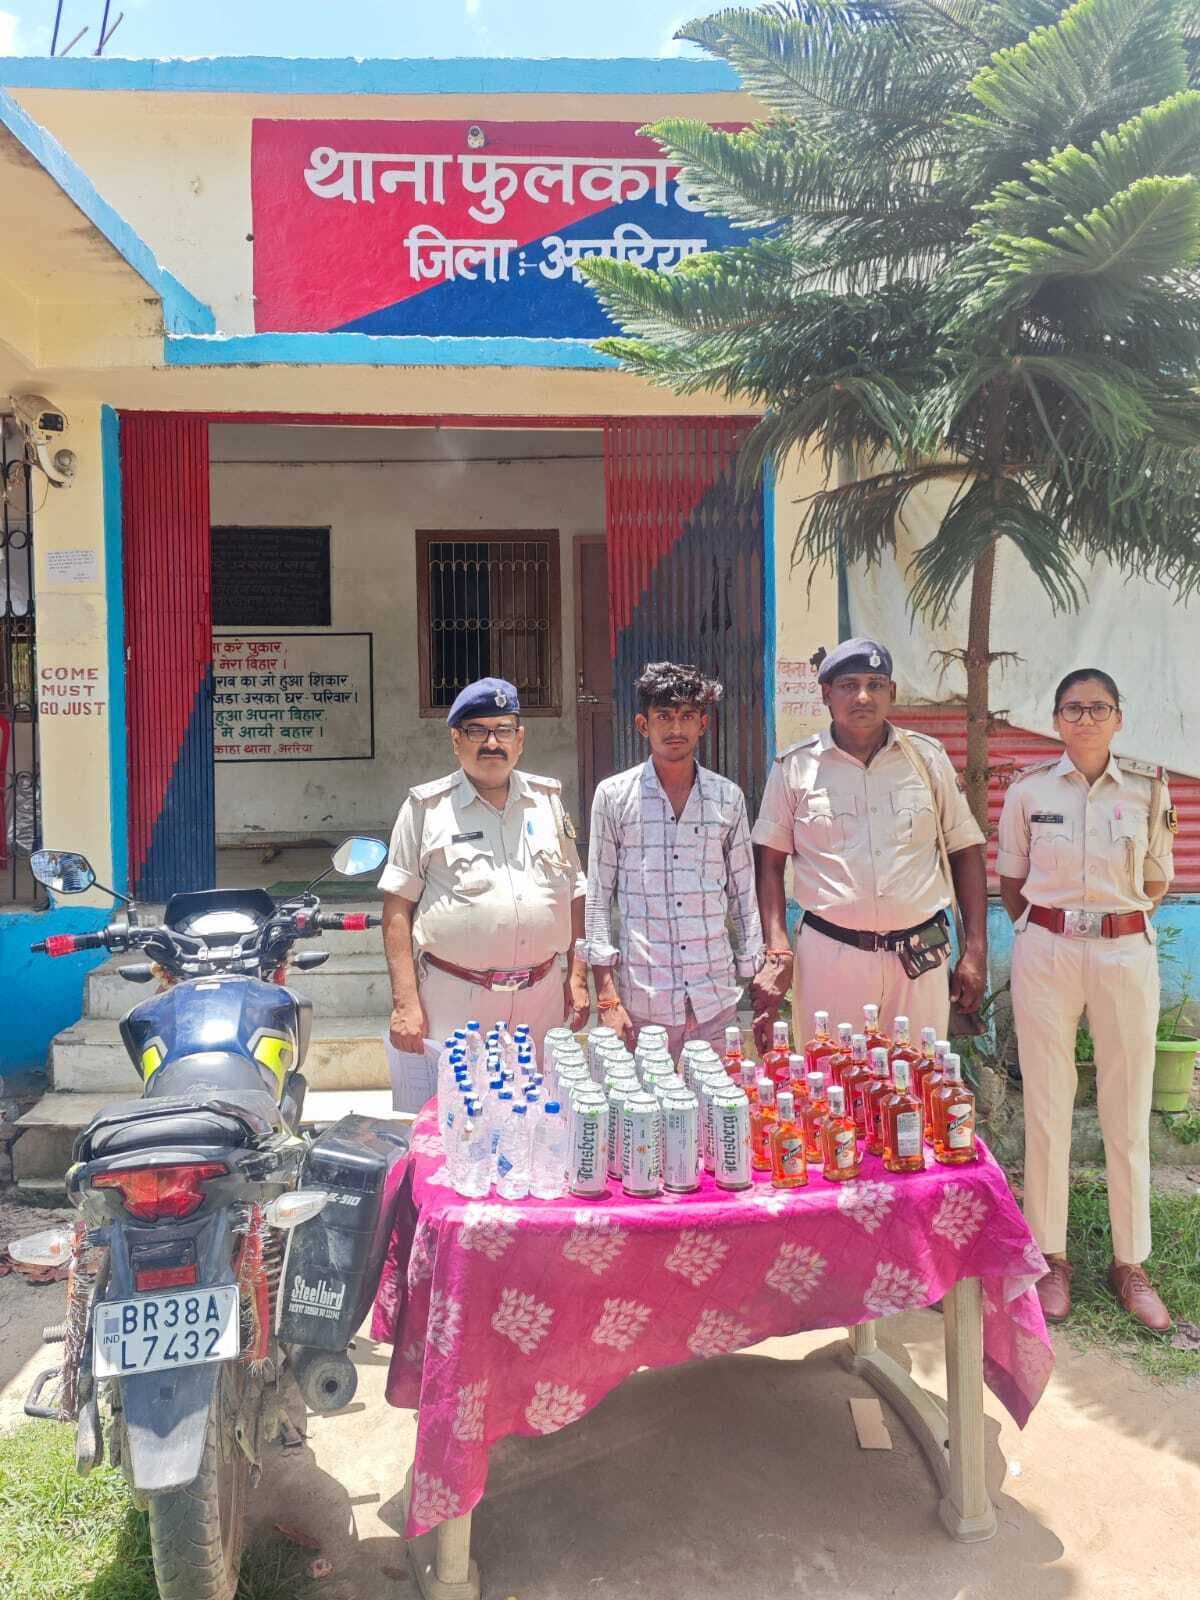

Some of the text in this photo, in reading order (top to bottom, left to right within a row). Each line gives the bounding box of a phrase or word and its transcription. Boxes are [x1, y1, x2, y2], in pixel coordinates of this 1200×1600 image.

[303, 146, 720, 225] थाना फुलका
[41, 667, 98, 681] COME
[214, 675, 239, 689] राब
[241, 675, 257, 688] का
[41, 684, 95, 697] MUST
[40, 702, 105, 716] GO JUST
[246, 709, 285, 722] अपना
[291, 1275, 346, 1309] Steelbird
[121, 1294, 219, 1335] BR38A
[103, 1334, 120, 1345] IND
[121, 1327, 219, 1370] L7432
